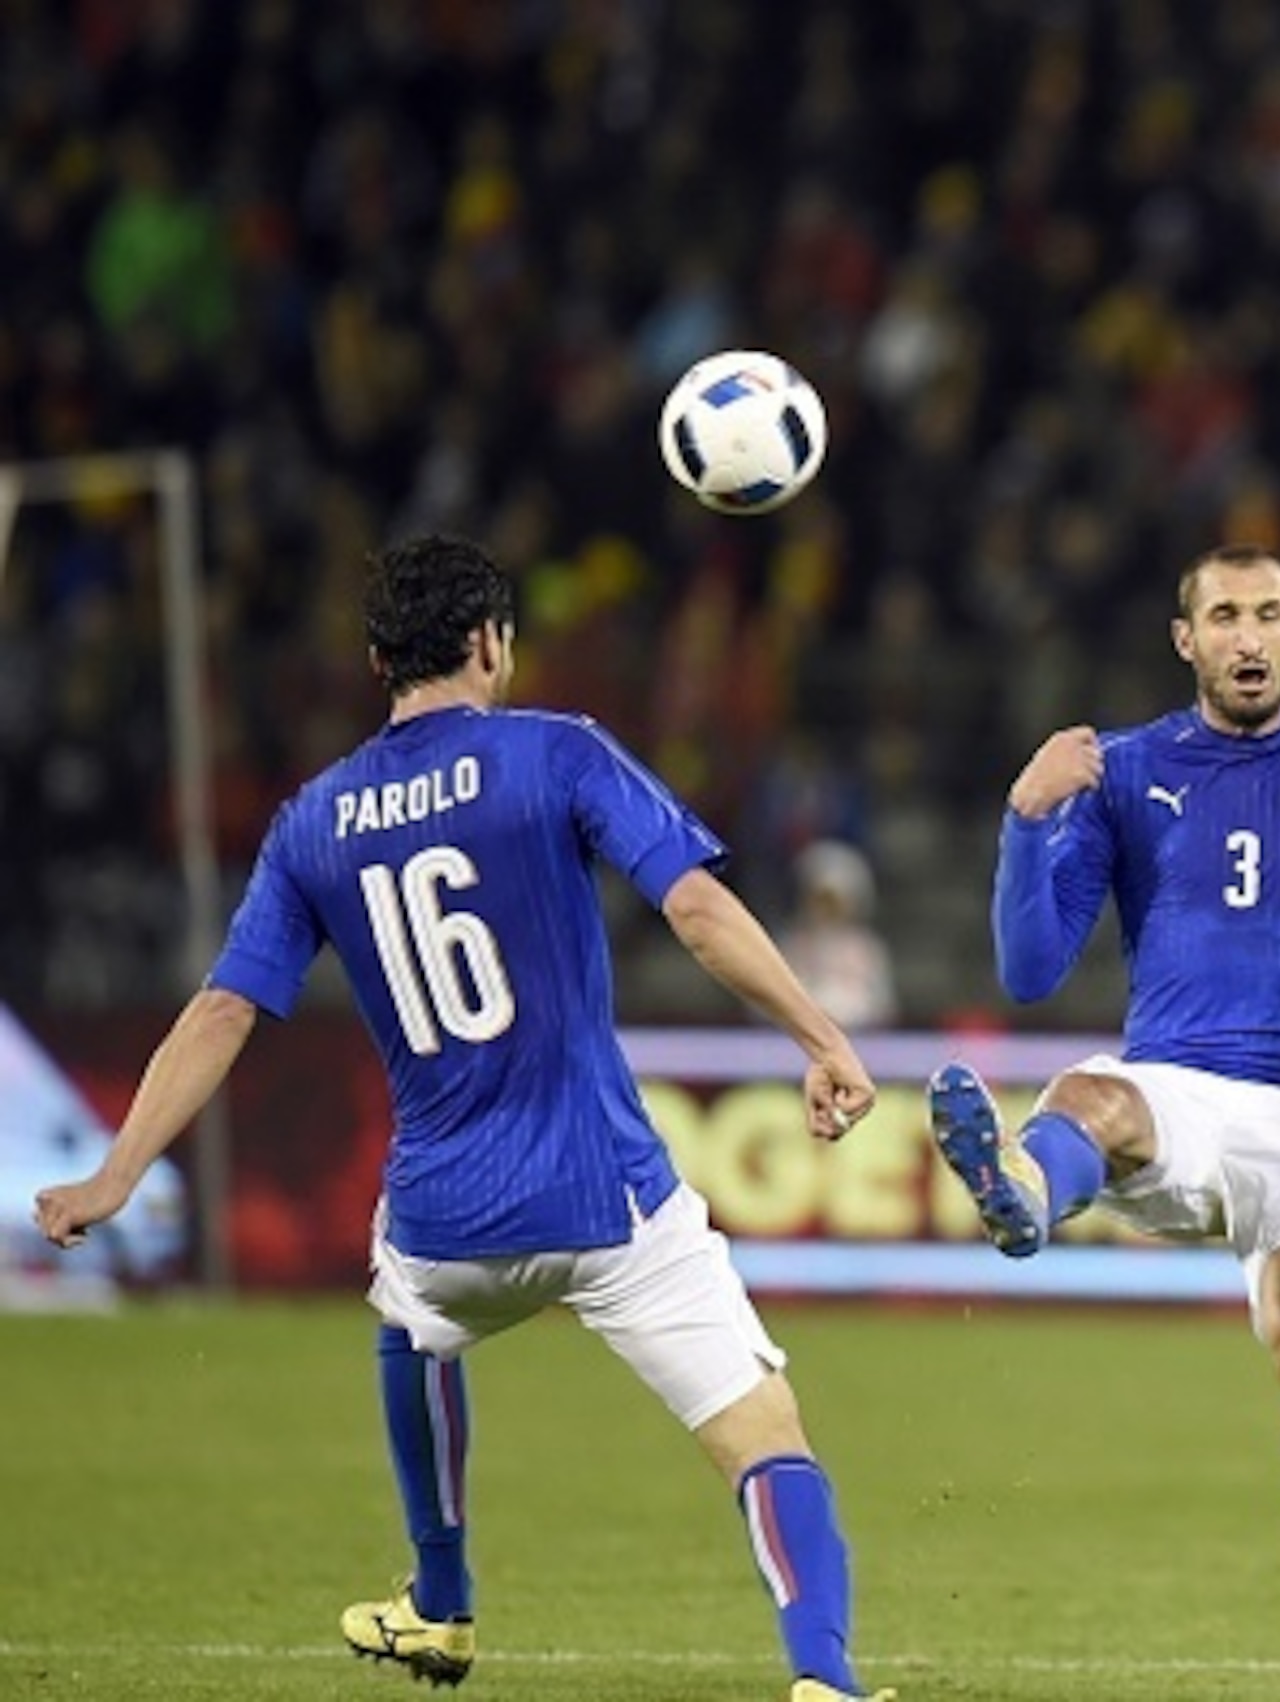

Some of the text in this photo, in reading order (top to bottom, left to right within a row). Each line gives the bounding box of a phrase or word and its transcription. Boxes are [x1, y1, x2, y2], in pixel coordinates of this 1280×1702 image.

[334, 756, 481, 838] PAROLO
[1222, 829, 1262, 909] 3
[359, 846, 515, 1056] 16
